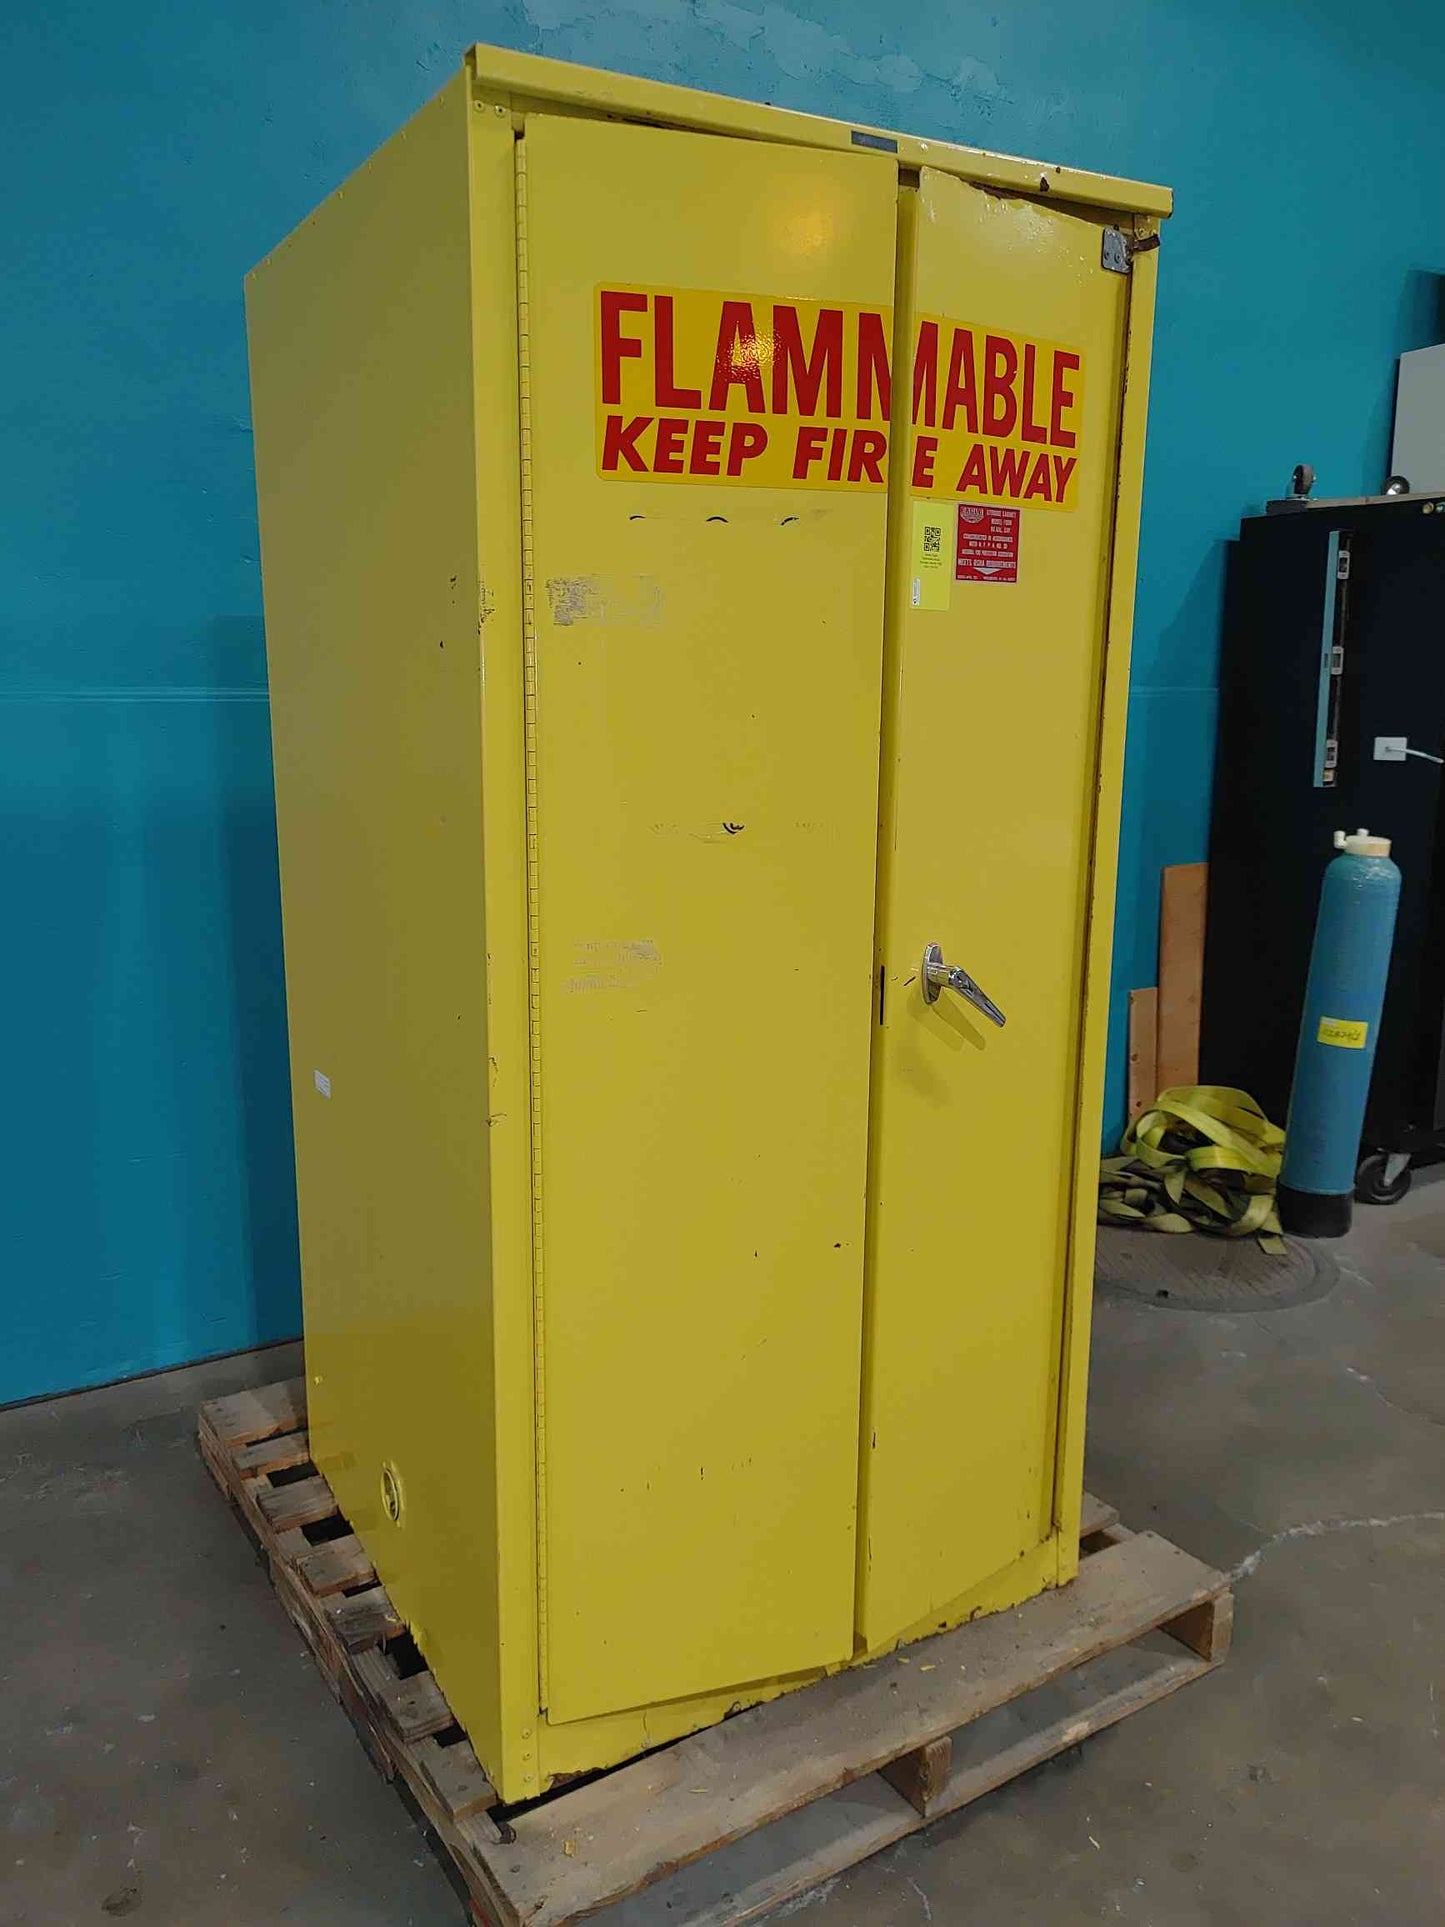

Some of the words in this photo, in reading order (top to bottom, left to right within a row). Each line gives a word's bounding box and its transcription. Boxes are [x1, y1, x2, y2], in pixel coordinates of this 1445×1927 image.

[600, 290, 1080, 449] FLAMMABLE
[601, 414, 769, 477] KEEP
[792, 425, 939, 488] FIRE
[955, 443, 1078, 504] AWAY
